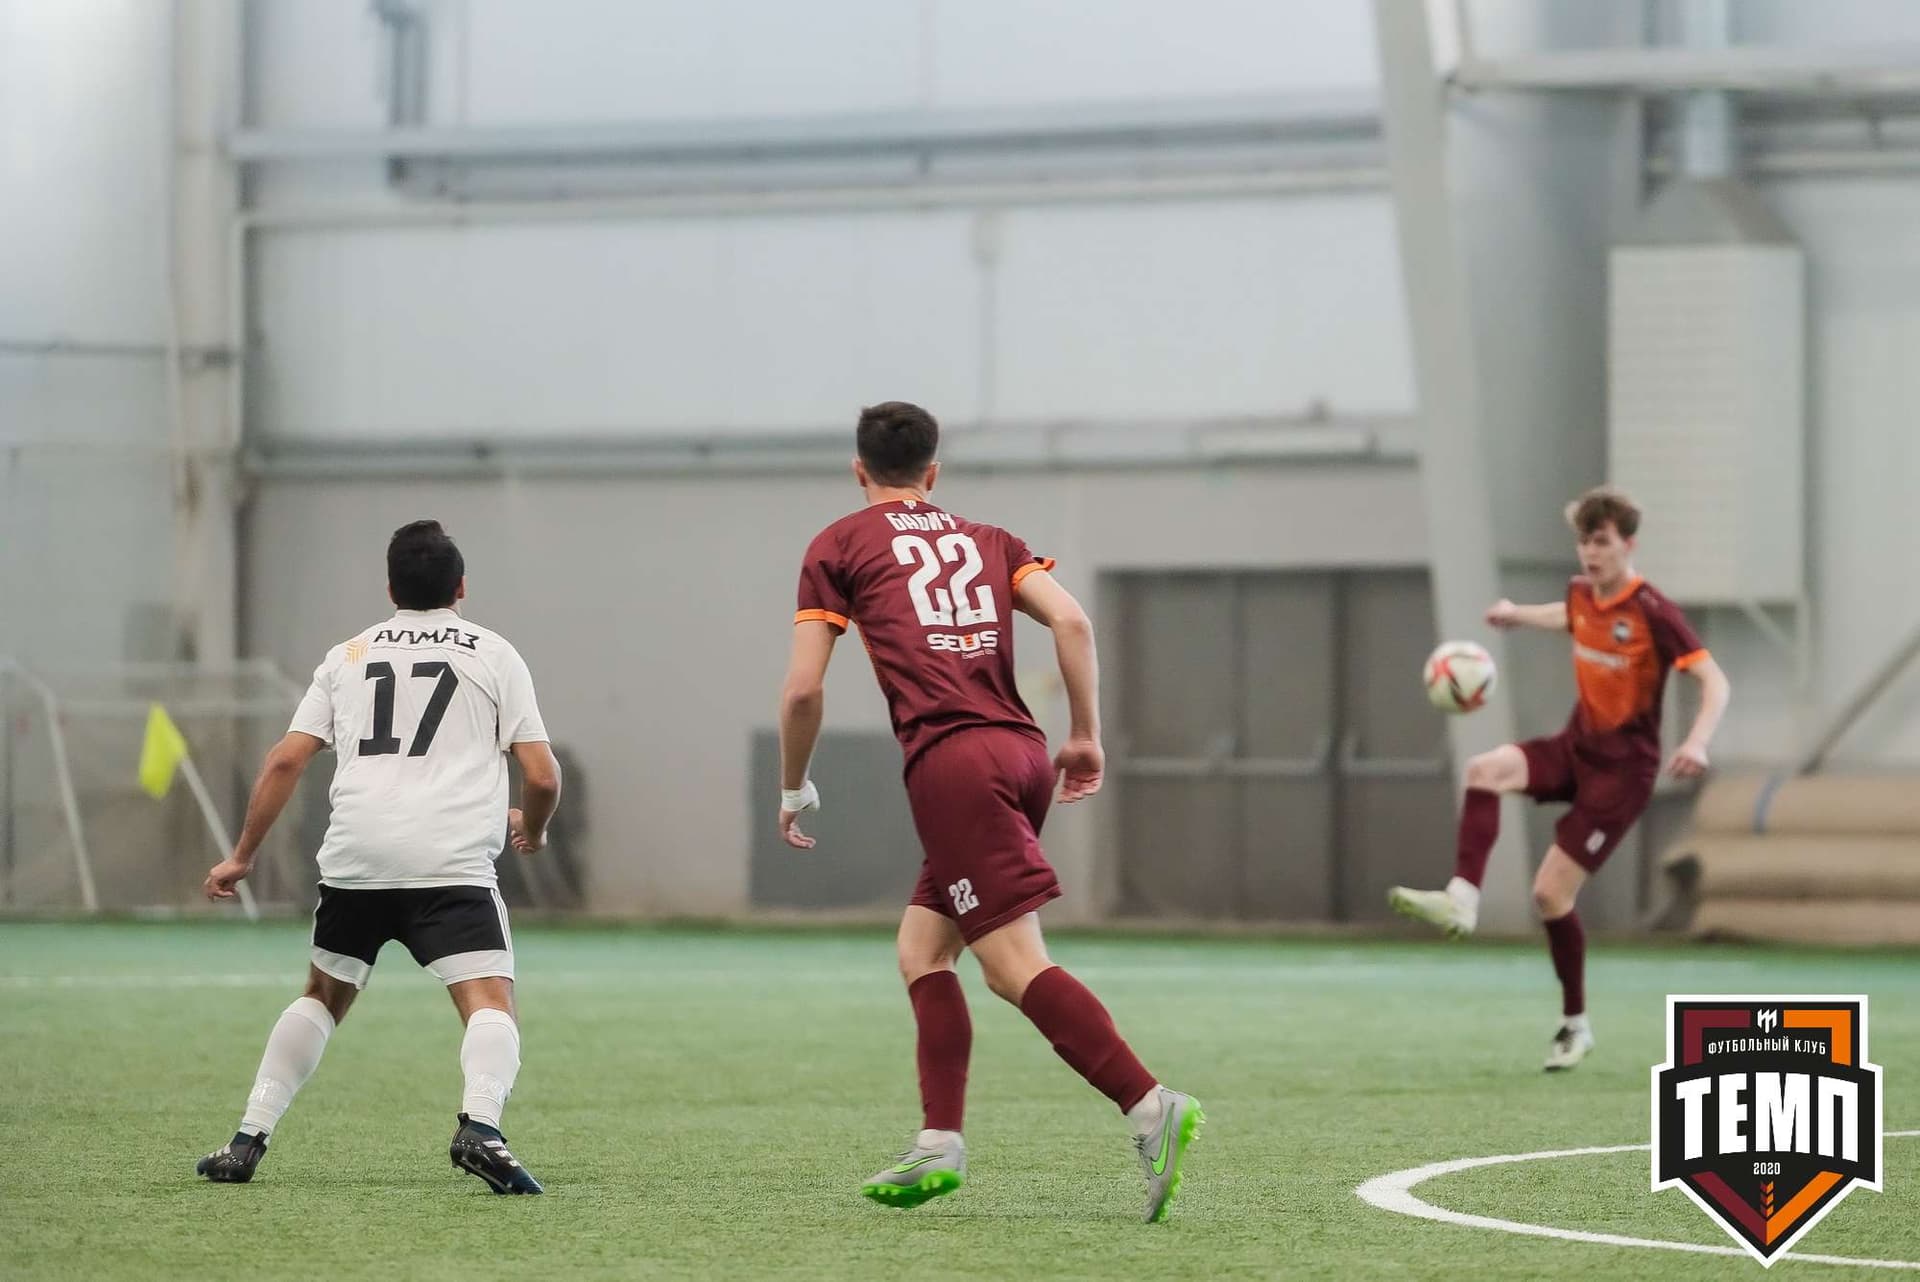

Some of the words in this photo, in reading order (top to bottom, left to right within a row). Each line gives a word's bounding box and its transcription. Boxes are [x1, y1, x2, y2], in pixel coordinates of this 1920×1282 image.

[885, 512, 957, 531] БАБИЧ
[891, 533, 998, 626] 22
[373, 627, 480, 650] АЛМАЗ
[926, 630, 999, 652] SEUS
[358, 661, 459, 757] 17
[948, 878, 980, 915] 22
